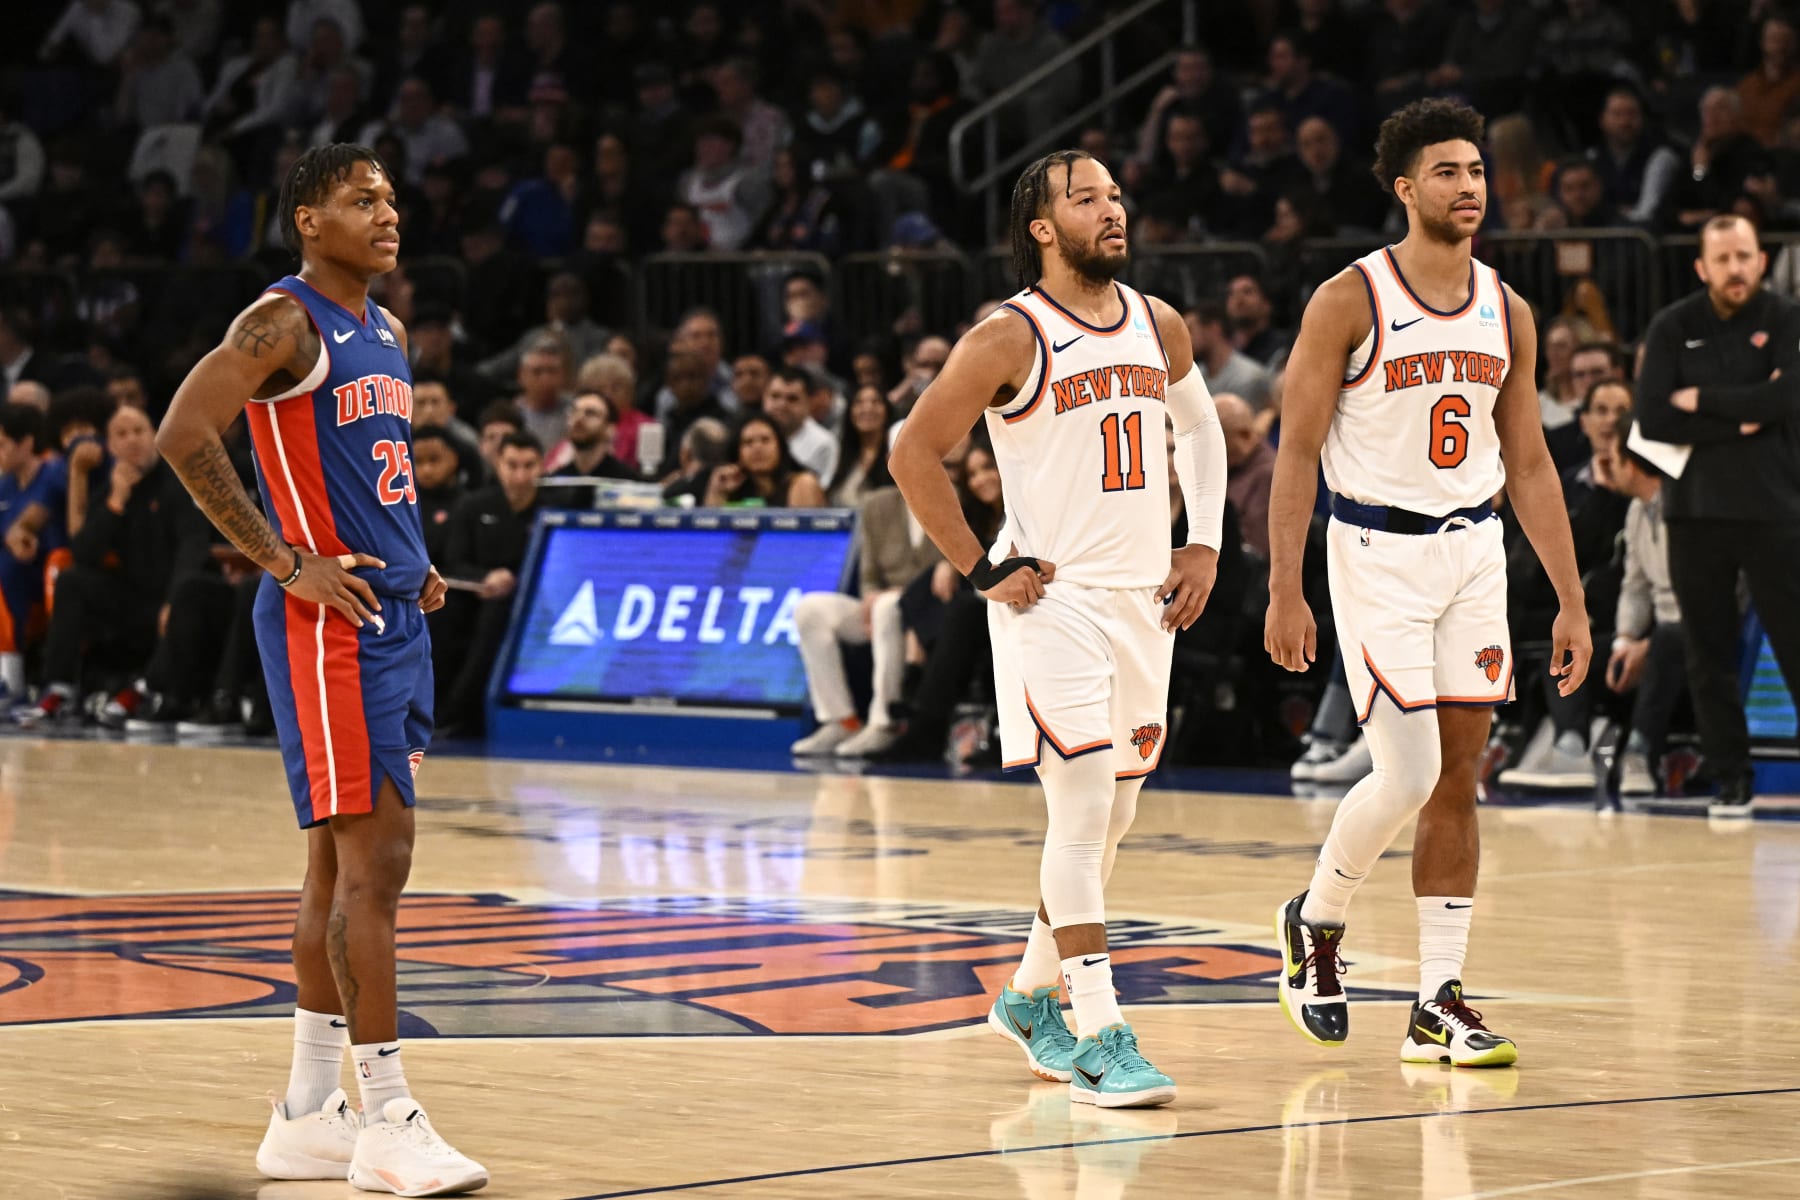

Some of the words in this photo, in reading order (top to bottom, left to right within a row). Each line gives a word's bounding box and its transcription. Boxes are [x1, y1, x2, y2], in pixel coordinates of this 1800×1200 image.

[333, 374, 413, 427] DETROI
[1051, 366, 1113, 415] NEW
[1113, 364, 1167, 403] YORK
[1384, 351, 1446, 393] NEW
[1447, 351, 1506, 390] YORK
[1100, 411, 1146, 492] 11
[1429, 394, 1471, 469] 6
[372, 439, 417, 506] 25
[612, 583, 801, 645] DELTA
